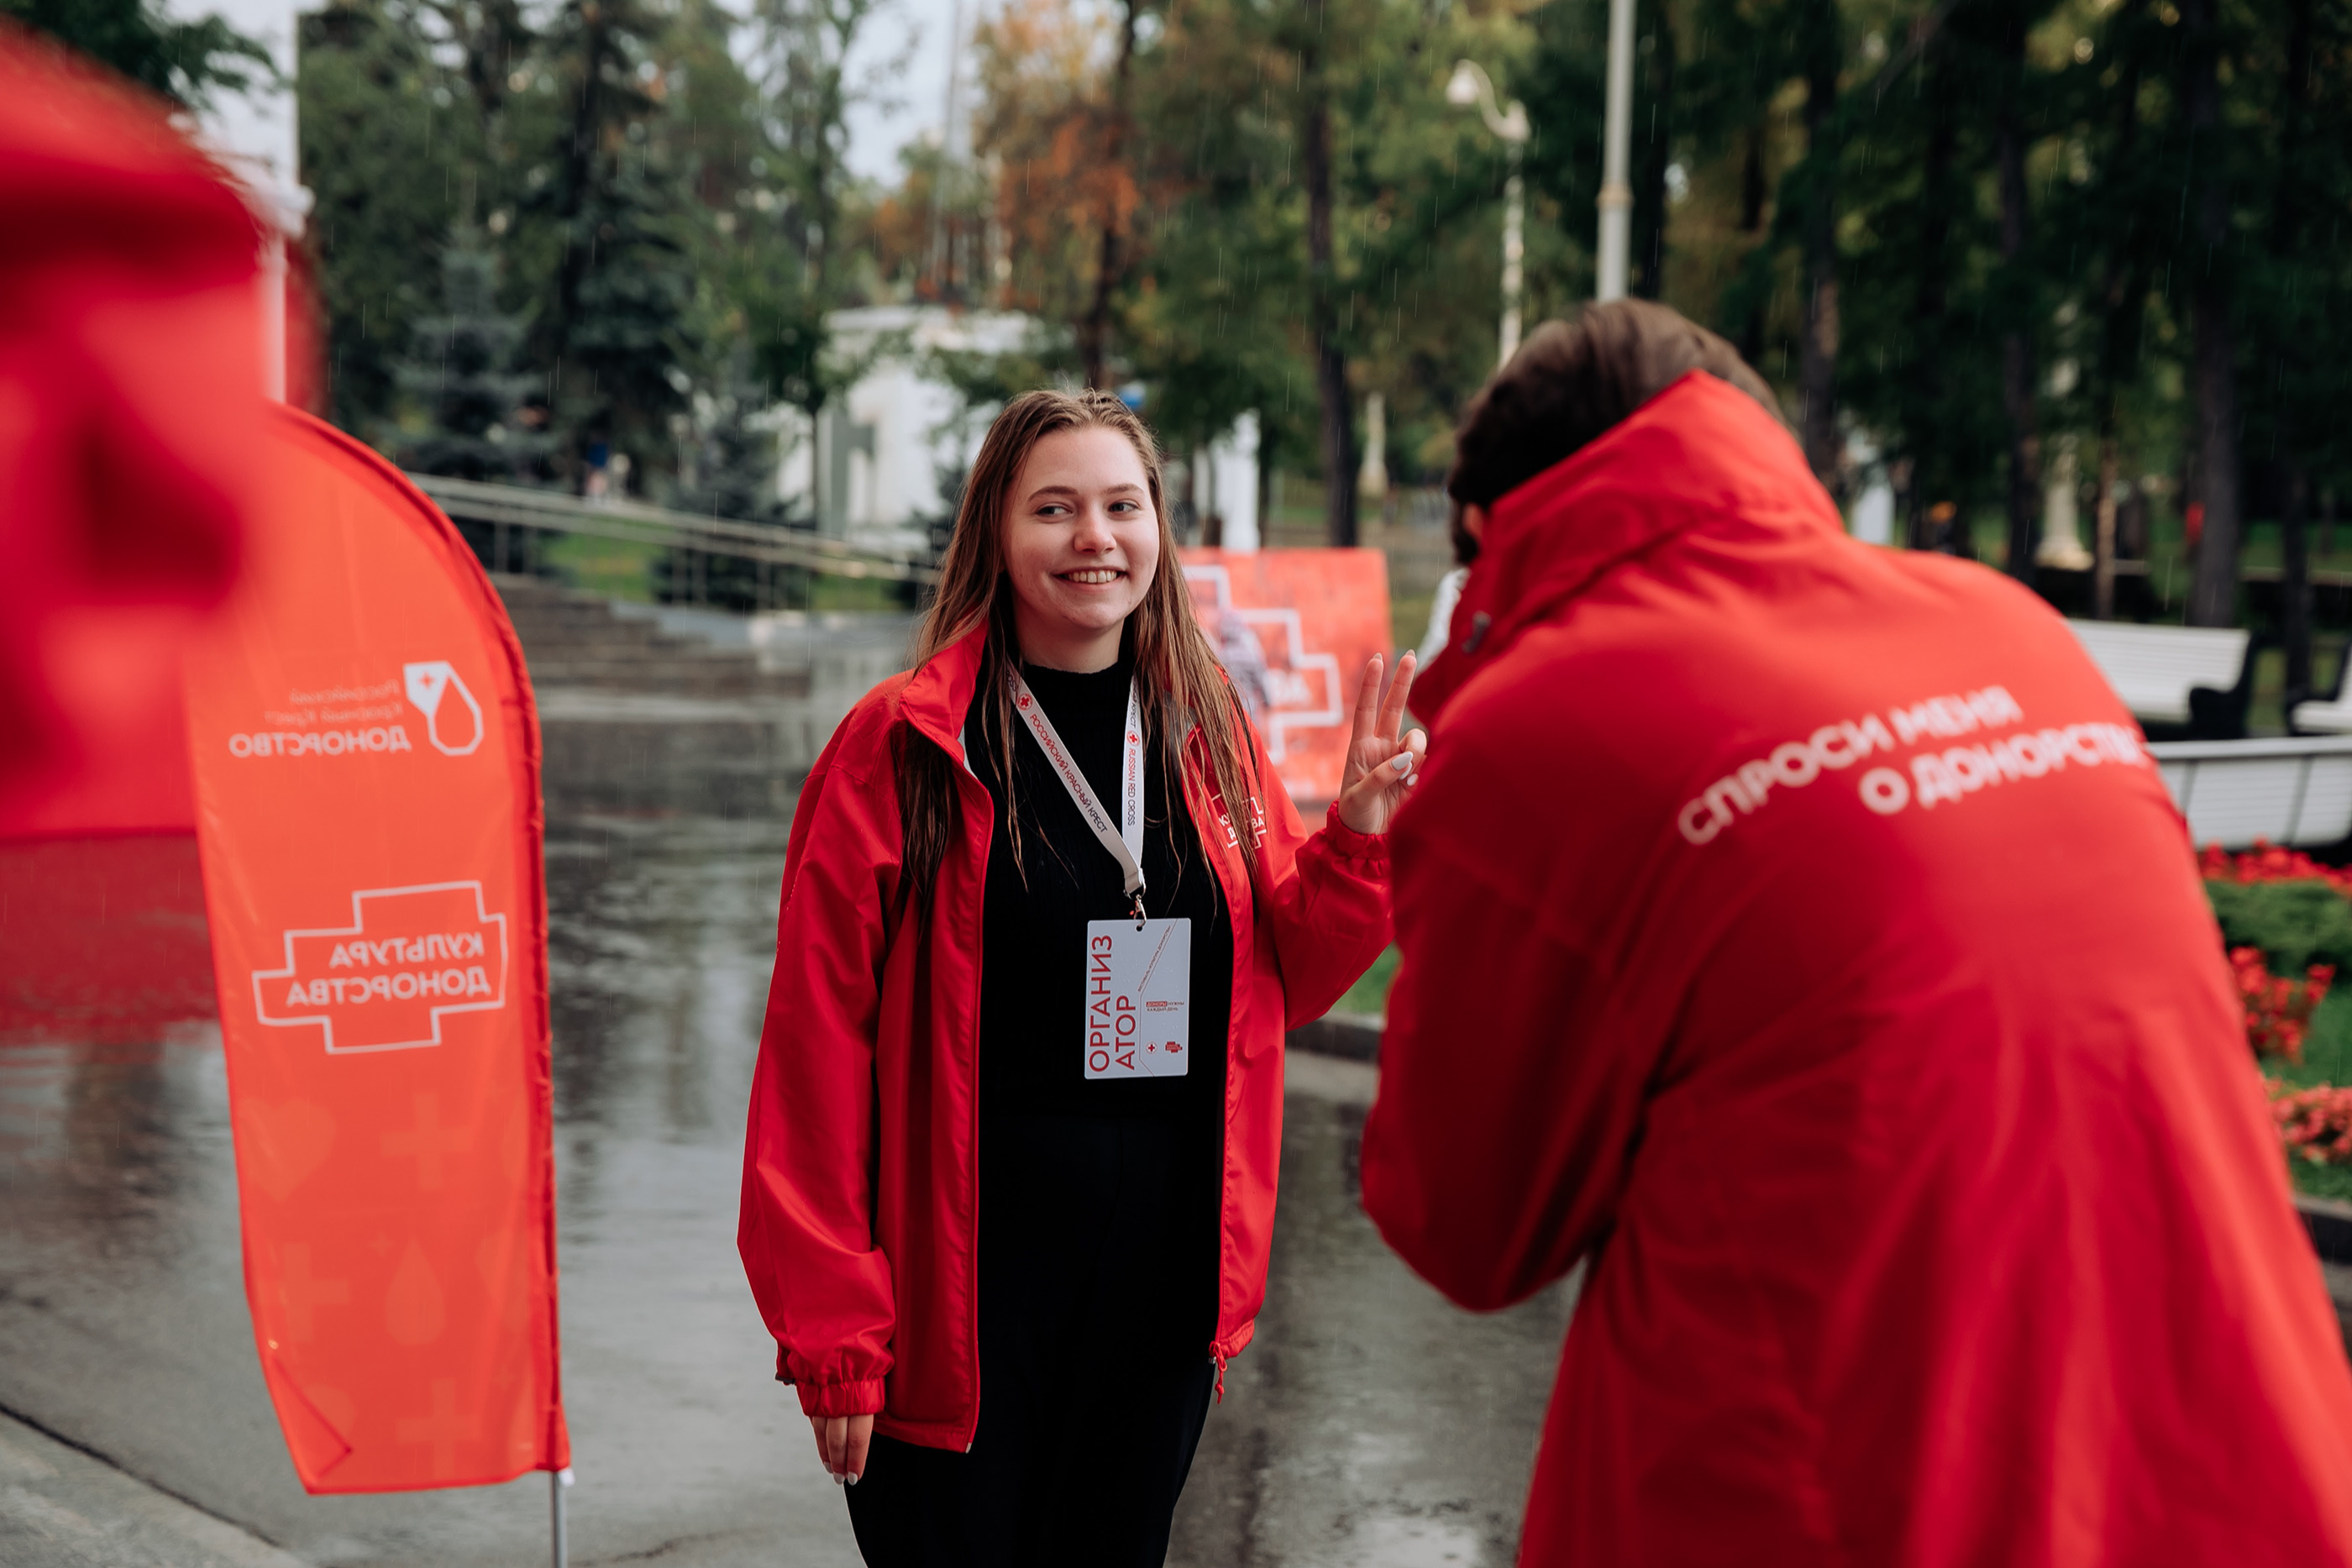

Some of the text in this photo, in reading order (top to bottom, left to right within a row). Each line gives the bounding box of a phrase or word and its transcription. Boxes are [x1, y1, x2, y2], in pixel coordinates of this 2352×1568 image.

[1030, 714, 1108, 832] РОССИЙСКИЙ КРАСНЫЙ КРЕСТ
[1127, 783, 1136, 798] RED
[1678, 684, 2024, 845] СПРОСИ МЕНЯ
[1858, 766, 1910, 815] О
[1127, 800, 1136, 826] CROSS
[1089, 935, 1112, 1072] ОРГАНИЗ
[1115, 995, 1137, 1071] АТОР
